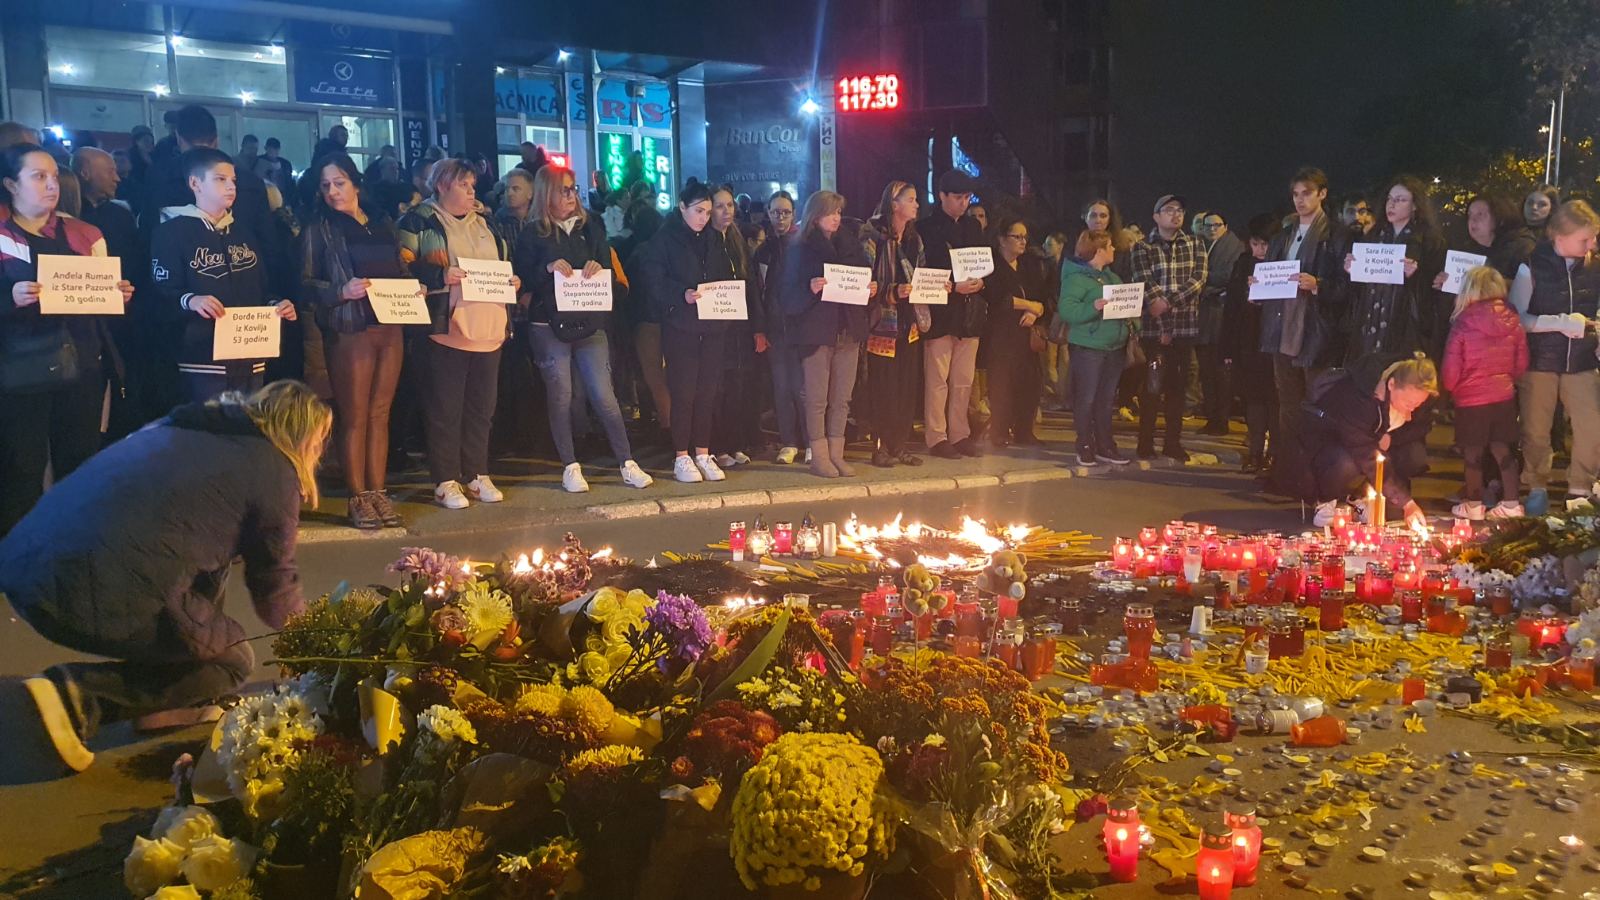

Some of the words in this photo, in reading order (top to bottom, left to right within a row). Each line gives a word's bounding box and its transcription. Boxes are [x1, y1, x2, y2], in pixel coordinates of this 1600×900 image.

[839, 74, 898, 94] 116.70
[839, 92, 898, 110] 117.30
[600, 99, 664, 122] RIS
[656, 155, 671, 210] RIS
[189, 247, 224, 269] New
[1371, 257, 1394, 266] Kovilja
[53, 272, 82, 280] Anđela
[85, 272, 113, 280] Ruman
[1369, 267, 1393, 275] godina
[52, 283, 59, 291] iz
[61, 283, 83, 291] Stare
[85, 283, 113, 291] Pazove
[580, 280, 601, 289] Švonja
[485, 287, 505, 295] godina
[64, 295, 75, 303] 20
[77, 295, 106, 305] godina
[232, 312, 255, 321] Đorđe
[256, 311, 272, 320] Firić
[235, 324, 242, 332] iz
[243, 323, 267, 333] Kovilja
[232, 336, 242, 344] 53
[243, 336, 269, 345] godine
